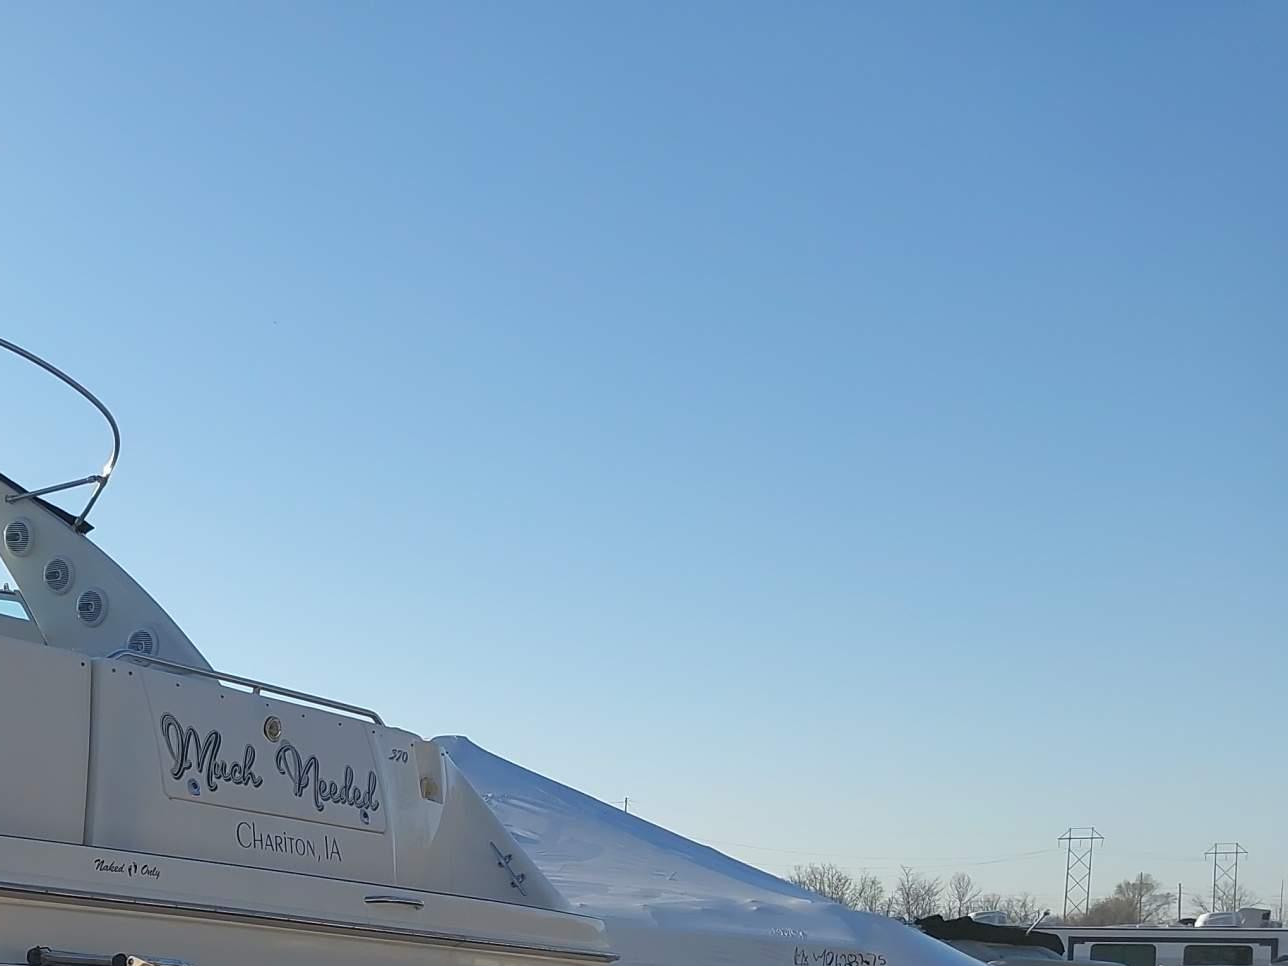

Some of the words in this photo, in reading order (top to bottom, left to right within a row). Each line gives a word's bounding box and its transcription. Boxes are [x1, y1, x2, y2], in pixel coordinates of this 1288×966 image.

[161, 712, 263, 792] Much
[276, 743, 379, 812] Needed
[324, 835, 342, 862] IA
[94, 858, 125, 873] Naked
[140, 864, 160, 880] Only
